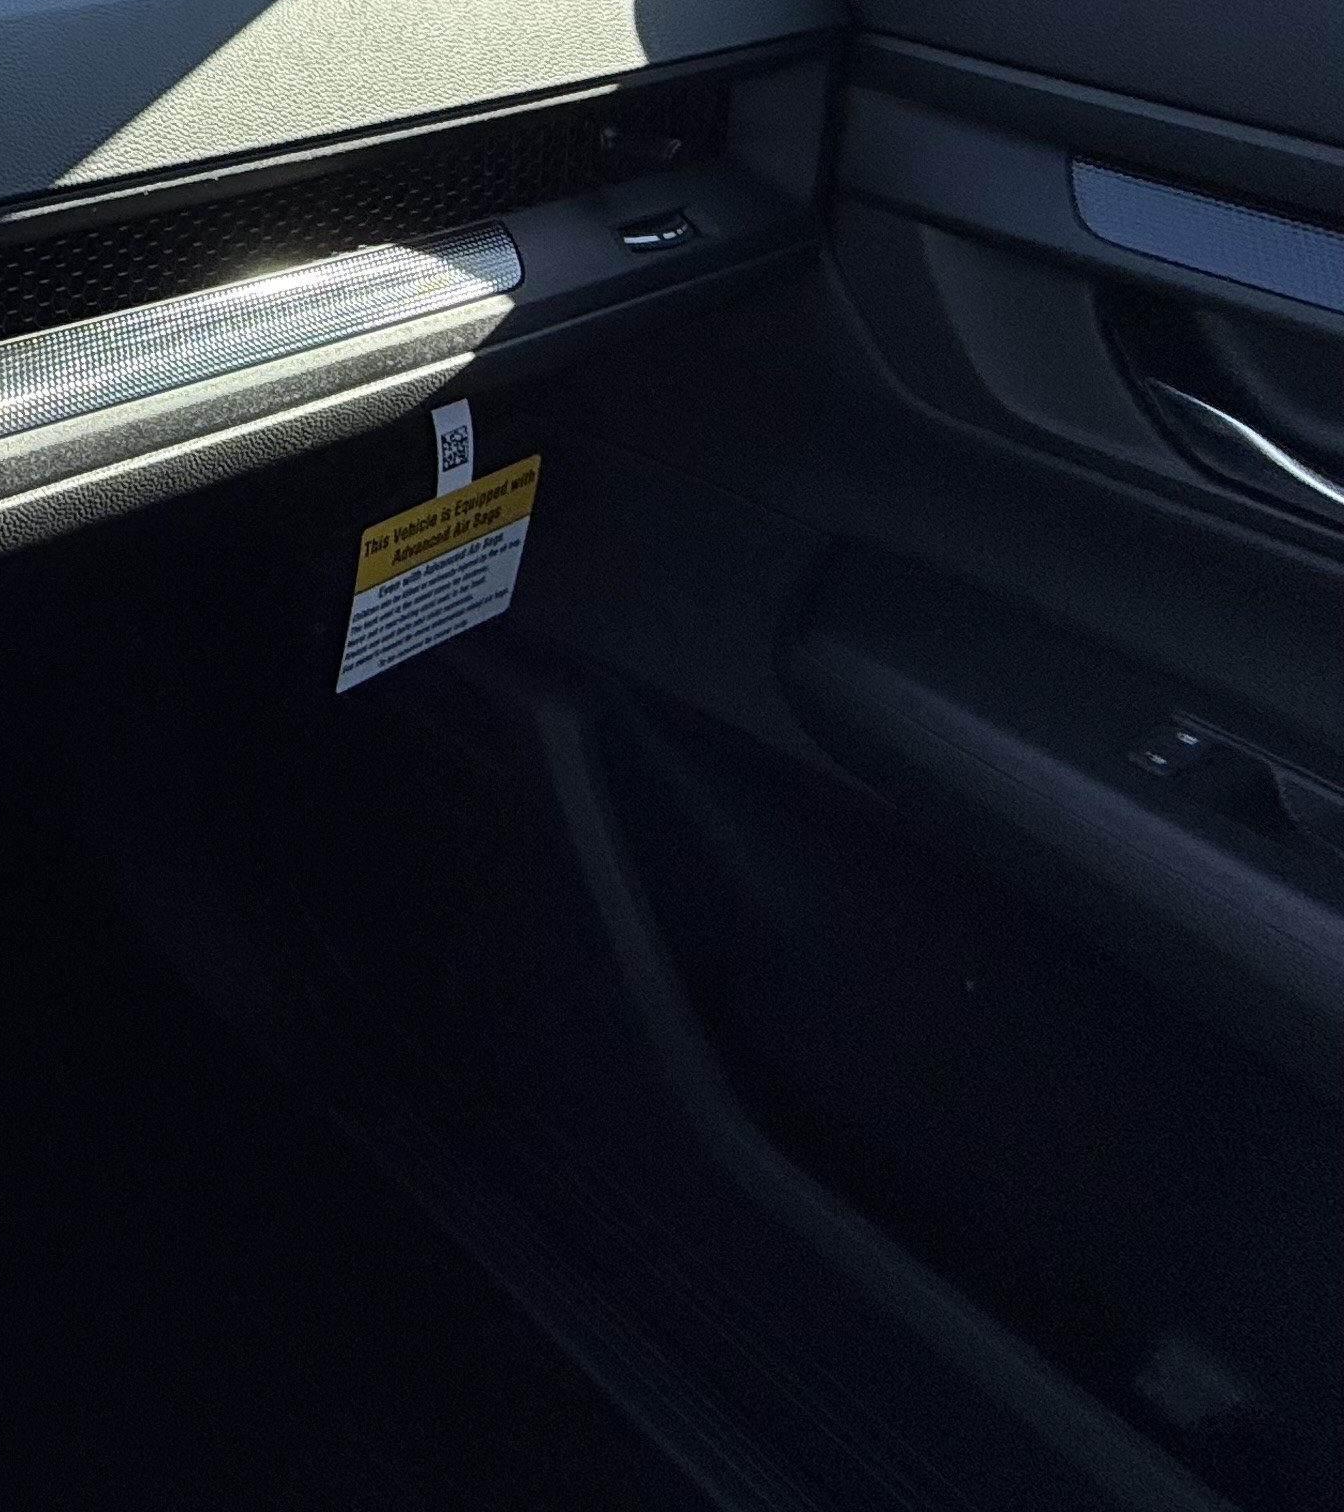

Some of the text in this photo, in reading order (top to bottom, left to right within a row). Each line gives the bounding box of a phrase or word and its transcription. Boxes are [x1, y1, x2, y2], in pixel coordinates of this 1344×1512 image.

[364, 469, 536, 557] This Vehicle is Equipped with
[392, 505, 502, 565] Advanced Air Bags
